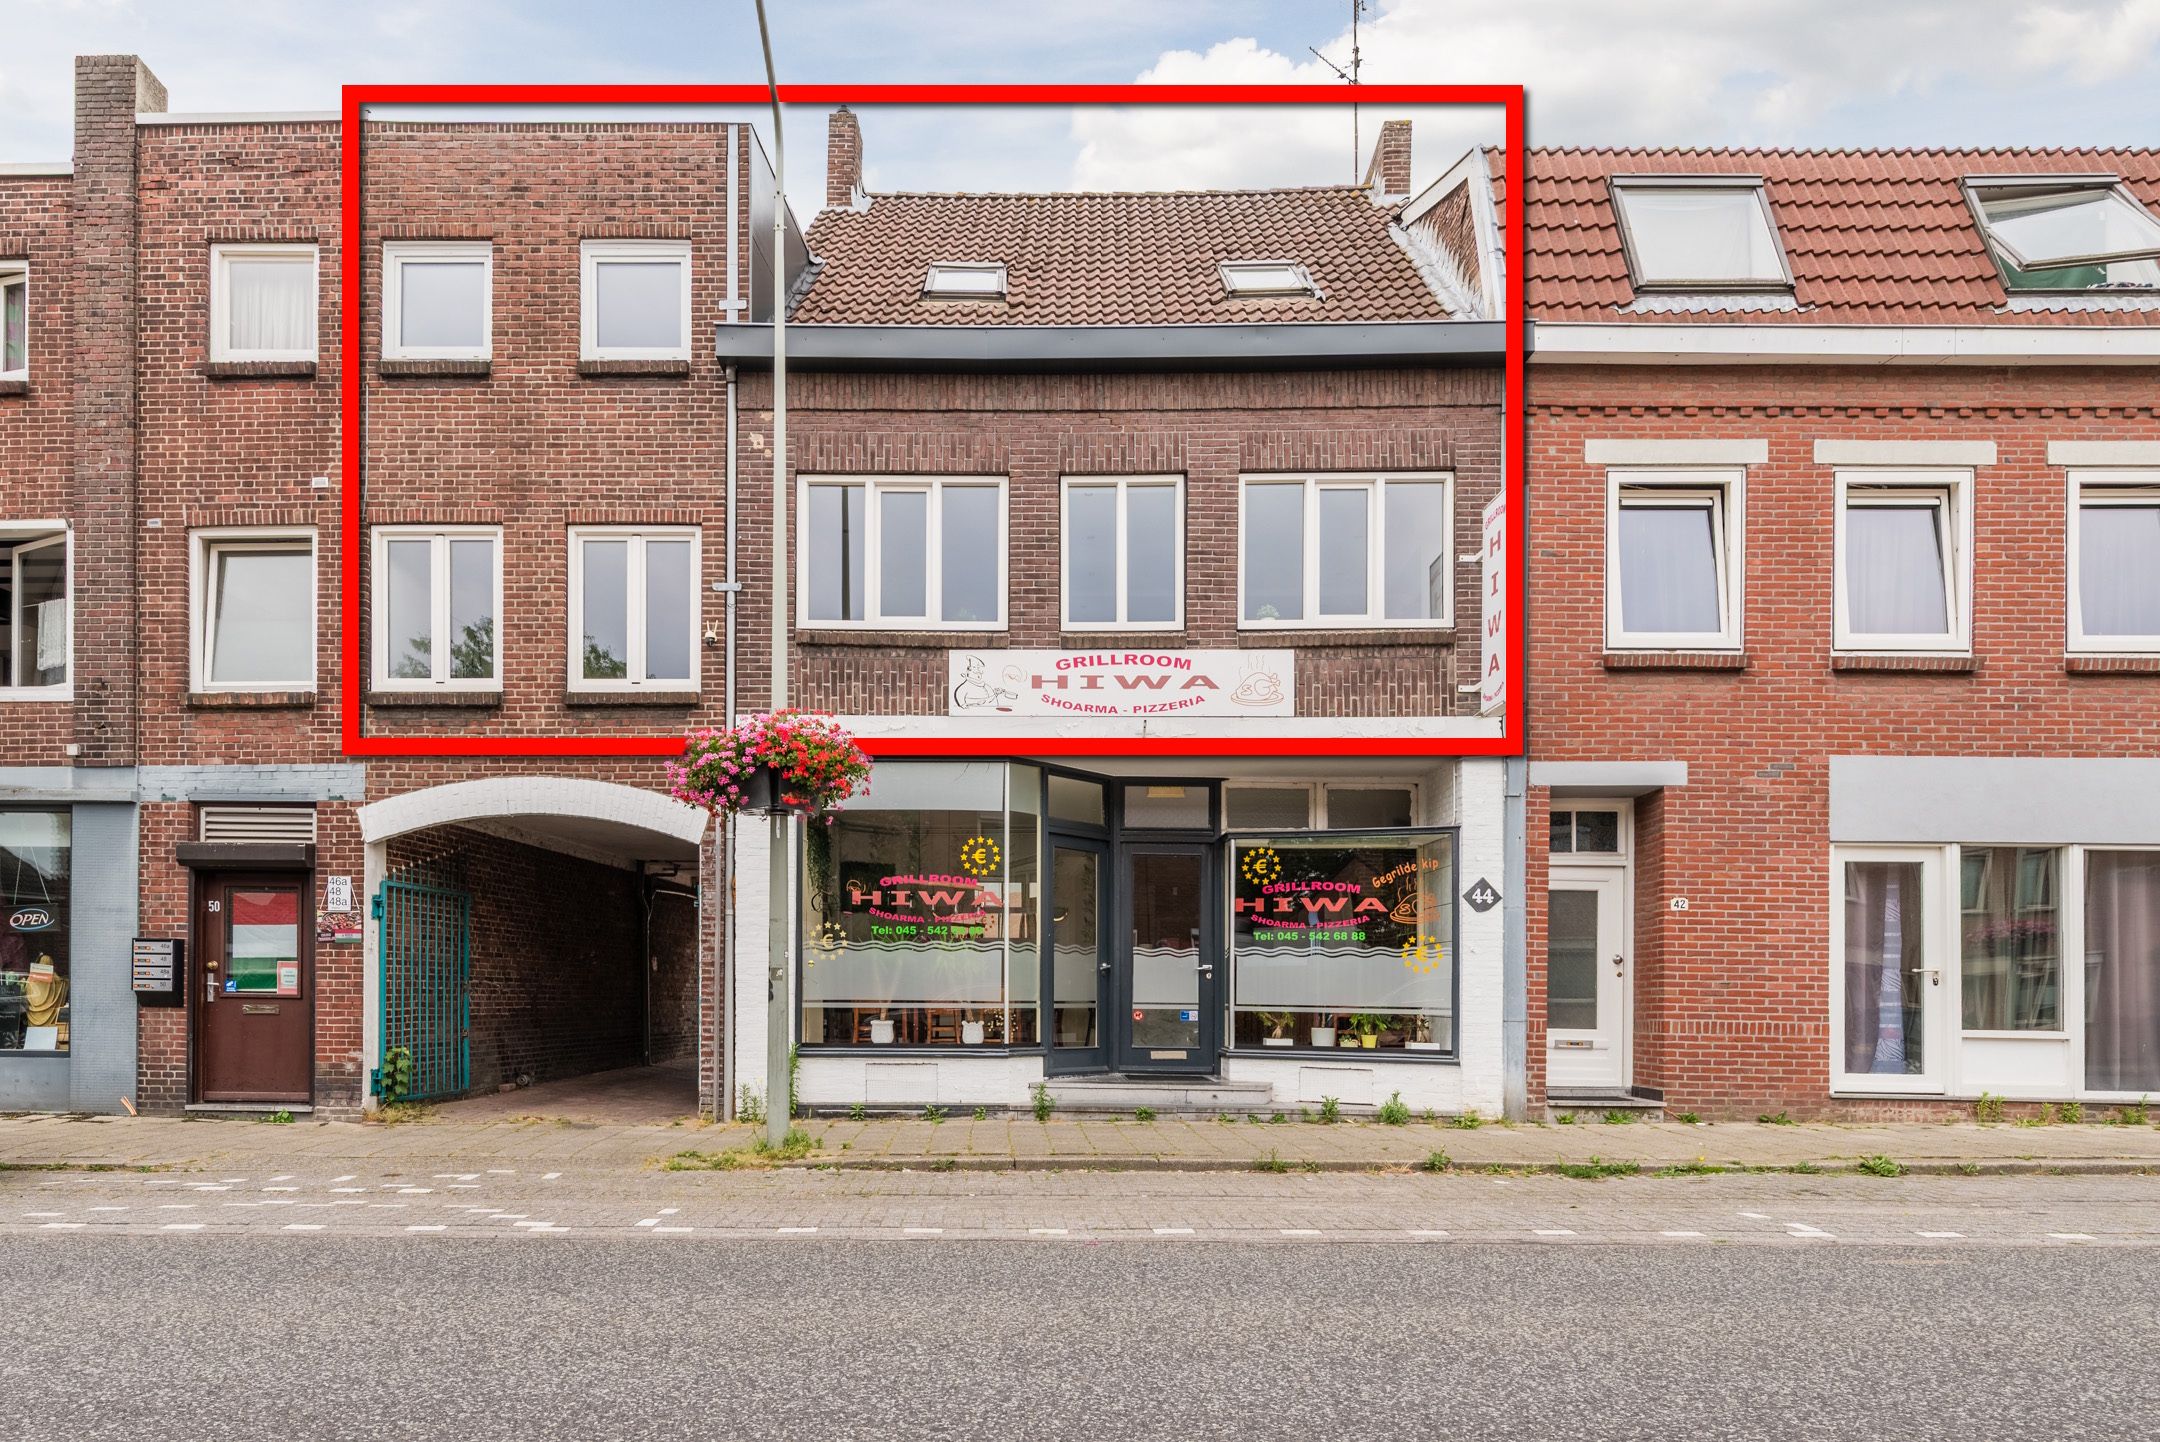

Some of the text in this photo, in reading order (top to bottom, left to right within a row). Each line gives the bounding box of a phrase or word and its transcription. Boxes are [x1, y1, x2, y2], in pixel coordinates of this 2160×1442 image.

[1487, 529, 1502, 677] HIWA
[1055, 653, 1192, 671] GRILLROOM
[1031, 675, 1220, 690] HIWA
[1041, 693, 1119, 714] SHOARMA
[1132, 694, 1206, 714] PIZZERIA
[879, 874, 978, 887] GRILLROOM
[1372, 858, 1440, 889] Gegrilde kip
[329, 877, 348, 886] 46a
[1262, 881, 1361, 895] GRILLROOM
[329, 887, 342, 896] 48
[851, 890, 1003, 907] HIWA
[1471, 888, 1494, 904] 44
[208, 900, 220, 912] 50
[329, 897, 348, 906] 48a
[1235, 897, 1389, 912] HIWA
[1673, 900, 1686, 909] 42
[9, 913, 48, 926] OPEN
[868, 907, 925, 923] SHOARMA
[1250, 914, 1306, 929] SHOARMA
[1317, 914, 1371, 929] PIZZERIA
[871, 925, 893, 935] Tel:
[895, 925, 917, 935] 045
[927, 925, 948, 935] 542
[1253, 931, 1274, 941] Tel:
[1277, 931, 1299, 941] 045
[1308, 931, 1330, 941] 542
[1333, 931, 1348, 941] 68
[1351, 931, 1366, 941] 88
